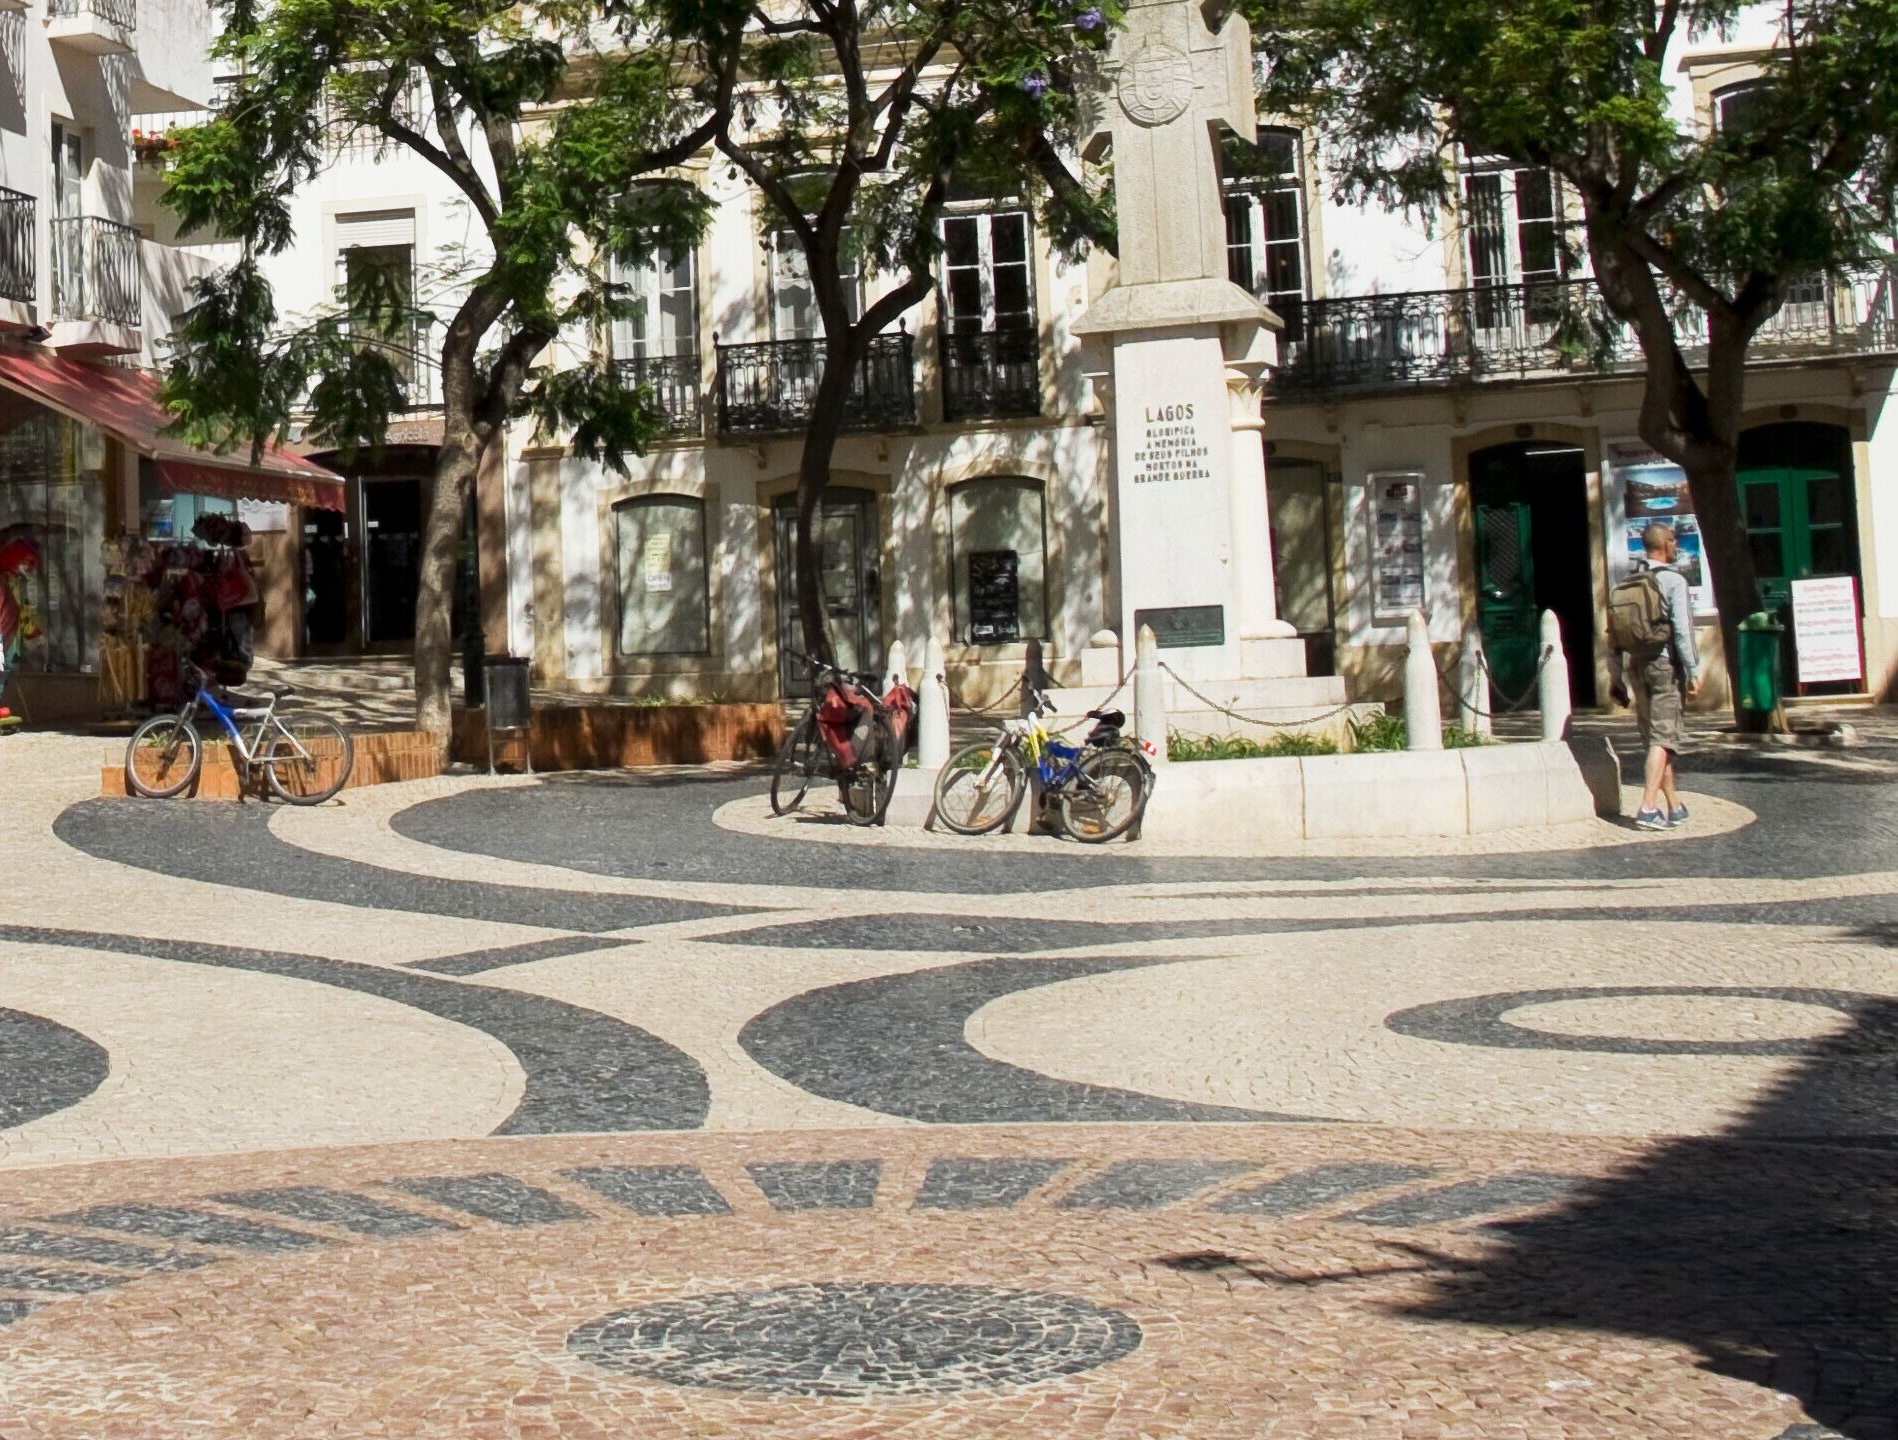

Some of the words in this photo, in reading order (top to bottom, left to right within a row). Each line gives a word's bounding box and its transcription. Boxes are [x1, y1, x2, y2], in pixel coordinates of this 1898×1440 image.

[1145, 403, 1194, 423] LAGOS
[1146, 426, 1195, 438] GLORIFICA
[1134, 452, 1146, 461] DE
[1149, 450, 1172, 460] SEUS
[1175, 447, 1208, 458] FILHOS
[1146, 460, 1183, 471] MORTOS
[1134, 472, 1170, 483] GRANDE
[1173, 469, 1210, 480] GUERRA
